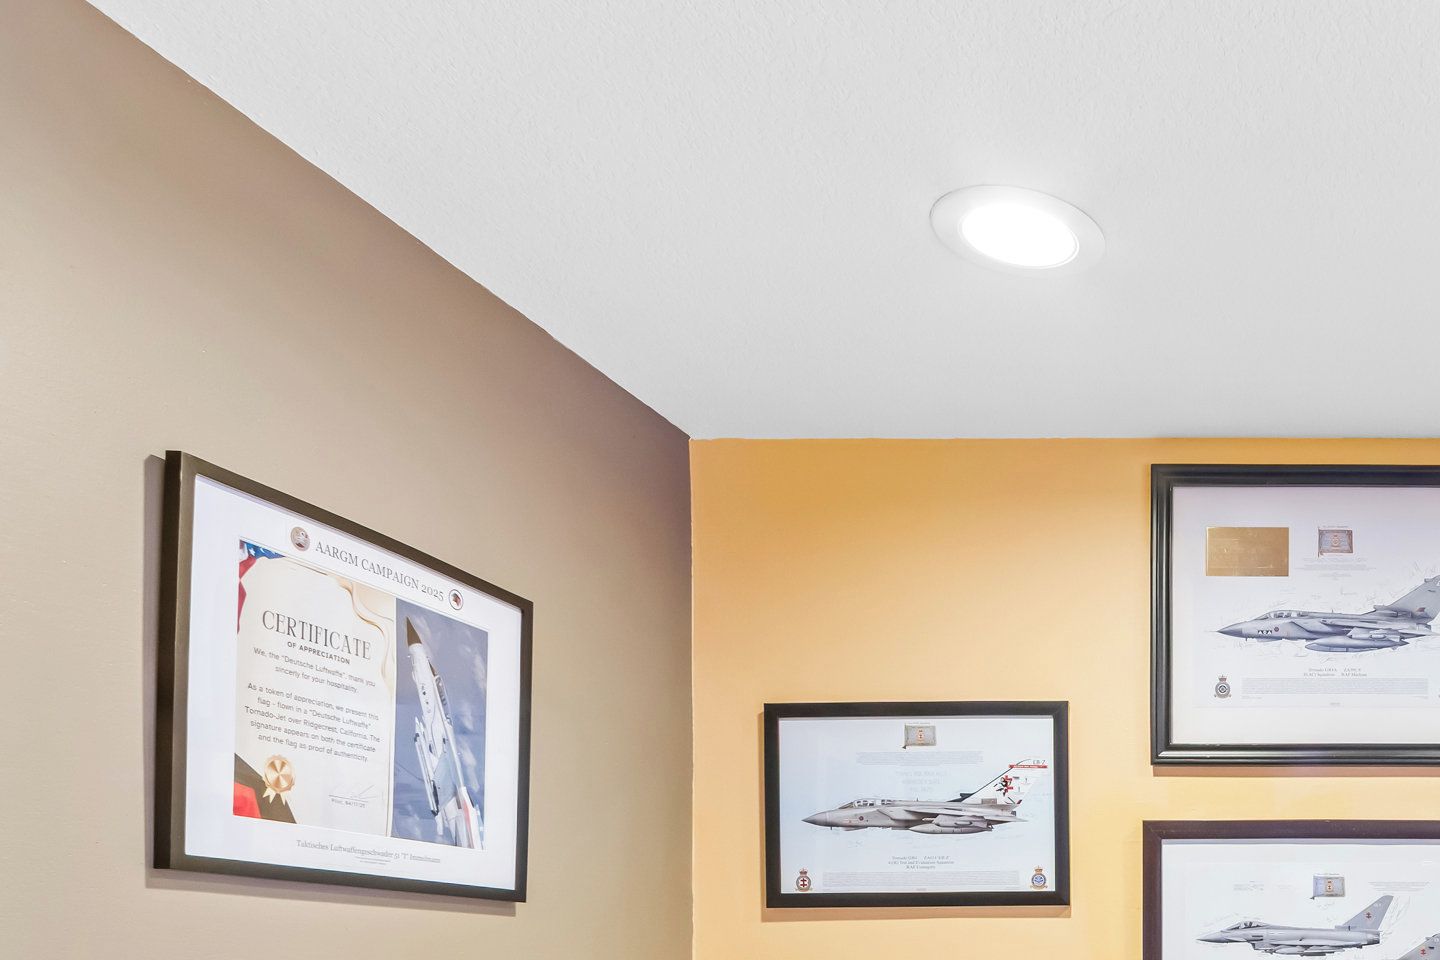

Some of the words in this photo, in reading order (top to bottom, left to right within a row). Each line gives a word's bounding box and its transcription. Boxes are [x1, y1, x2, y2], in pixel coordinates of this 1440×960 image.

[315, 541, 358, 567] AARGM
[361, 558, 419, 590] CAMPAIGN
[421, 584, 444, 601] 2025
[262, 610, 371, 660] CERTIFICATE
[269, 651, 280, 660] the
[287, 641, 297, 649] OF
[299, 645, 351, 665] APPRECIATION
[302, 671, 310, 680] for
[311, 676, 325, 684] your
[248, 683, 257, 691] As
[265, 686, 284, 697] token
[345, 707, 367, 718] present
[257, 697, 271, 708] flag
[277, 701, 294, 711] flown
[250, 720, 282, 732] signature
[283, 728, 310, 739] appears
[321, 735, 335, 744] both
[336, 738, 346, 746] the
[258, 733, 271, 742] and
[285, 739, 298, 749] flag
[308, 743, 325, 753] proof
